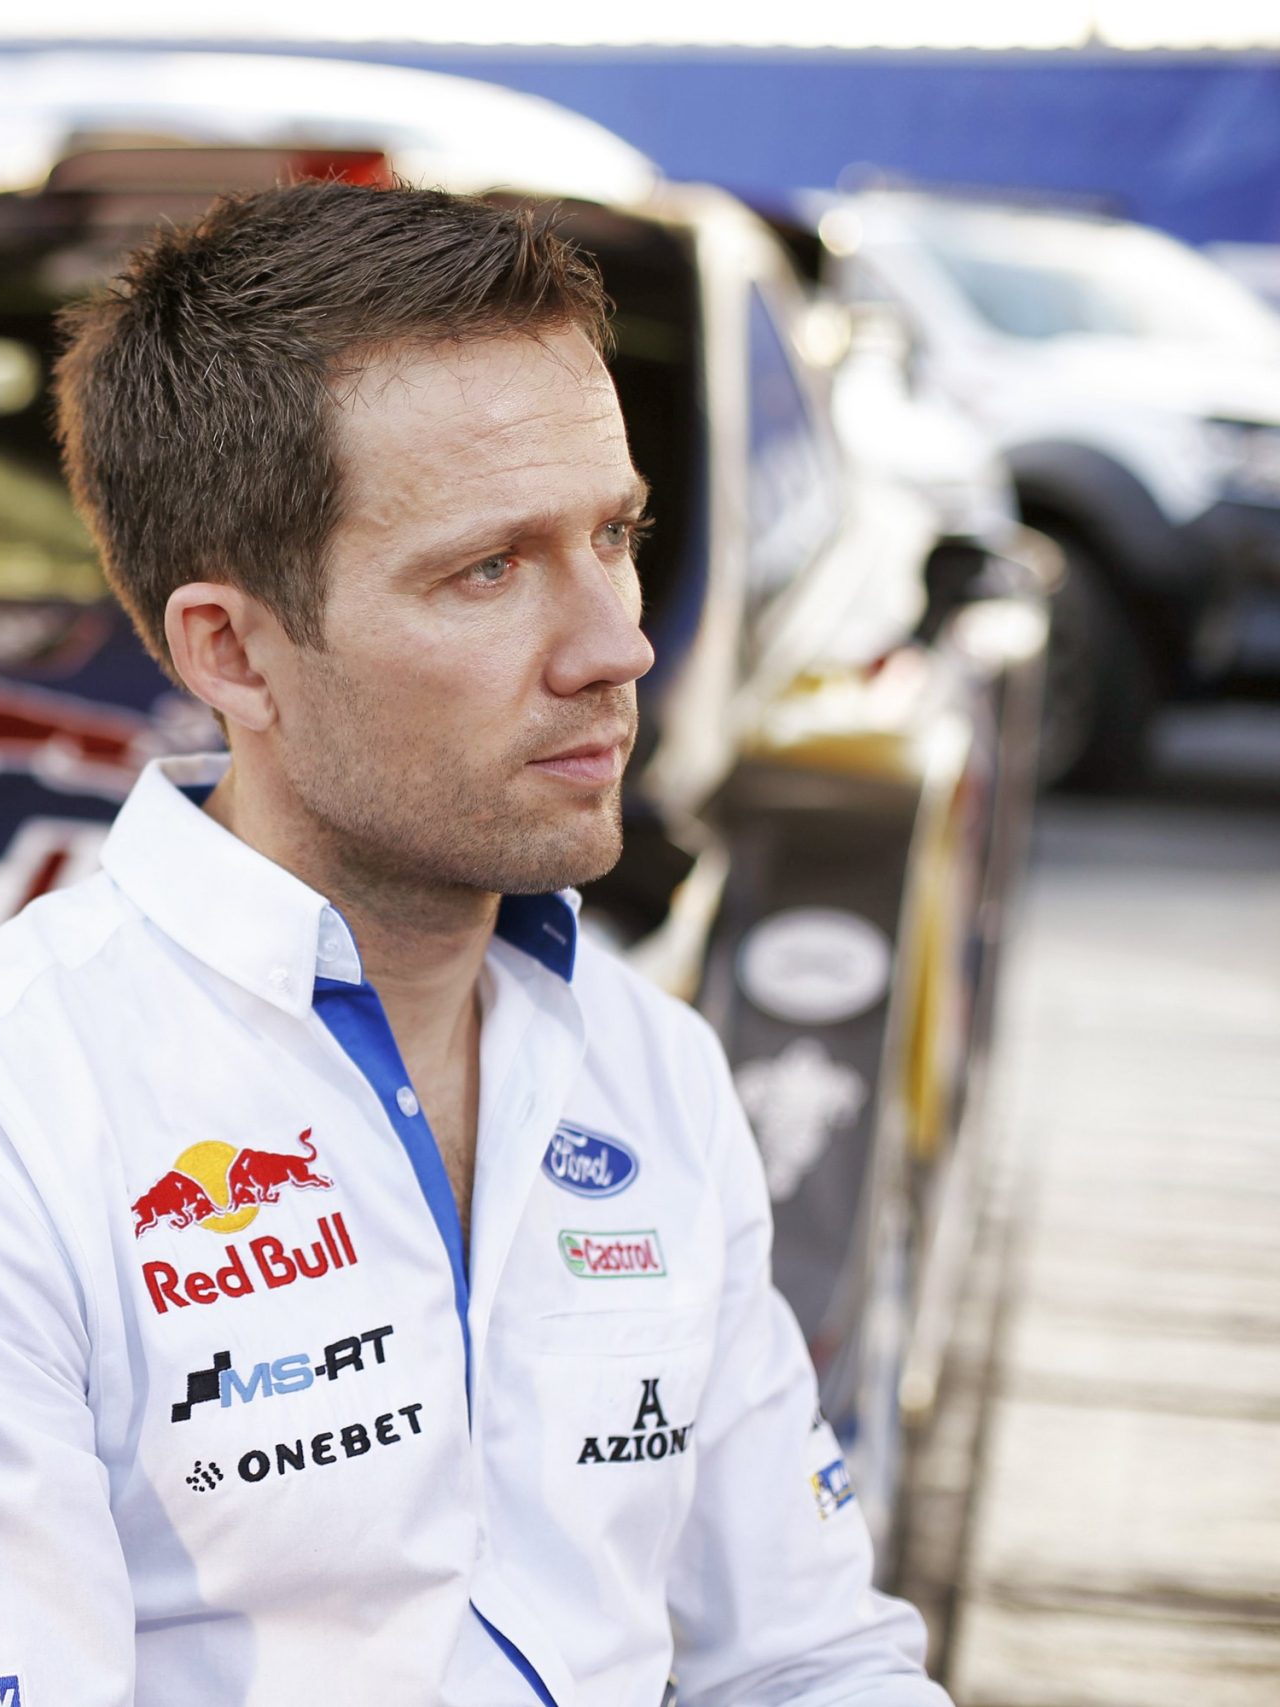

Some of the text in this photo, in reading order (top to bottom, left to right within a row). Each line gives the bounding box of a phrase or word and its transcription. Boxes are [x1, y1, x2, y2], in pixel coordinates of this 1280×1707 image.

[549, 1128, 613, 1187] Ford
[142, 1212, 358, 1314] Red Bull
[583, 1230, 659, 1272] Castrol
[220, 1325, 394, 1408] MS-RT
[237, 1403, 423, 1483] ONEBET
[576, 1423, 695, 1464] AZION
